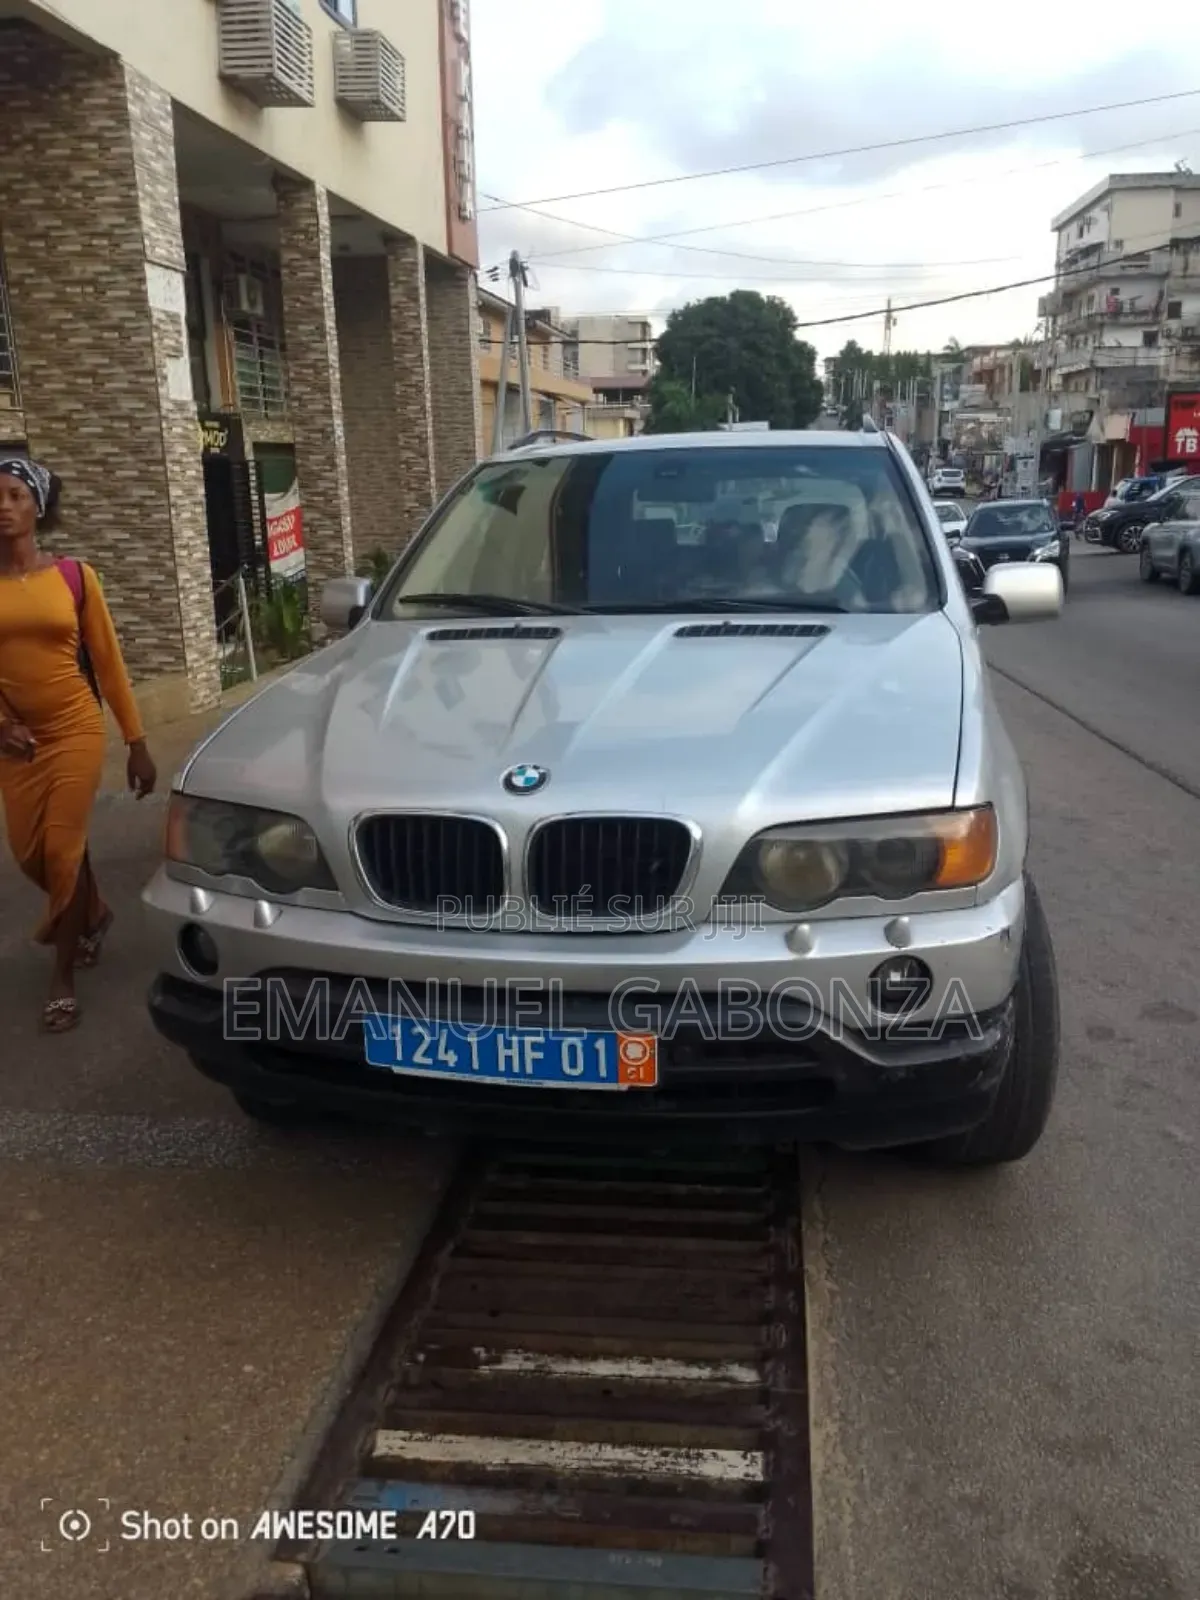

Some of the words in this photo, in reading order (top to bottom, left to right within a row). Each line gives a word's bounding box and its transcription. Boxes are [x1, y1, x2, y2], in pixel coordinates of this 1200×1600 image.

[391, 1023, 480, 1071] 1241
[497, 1033, 545, 1075] HF
[561, 1037, 608, 1078] 01
